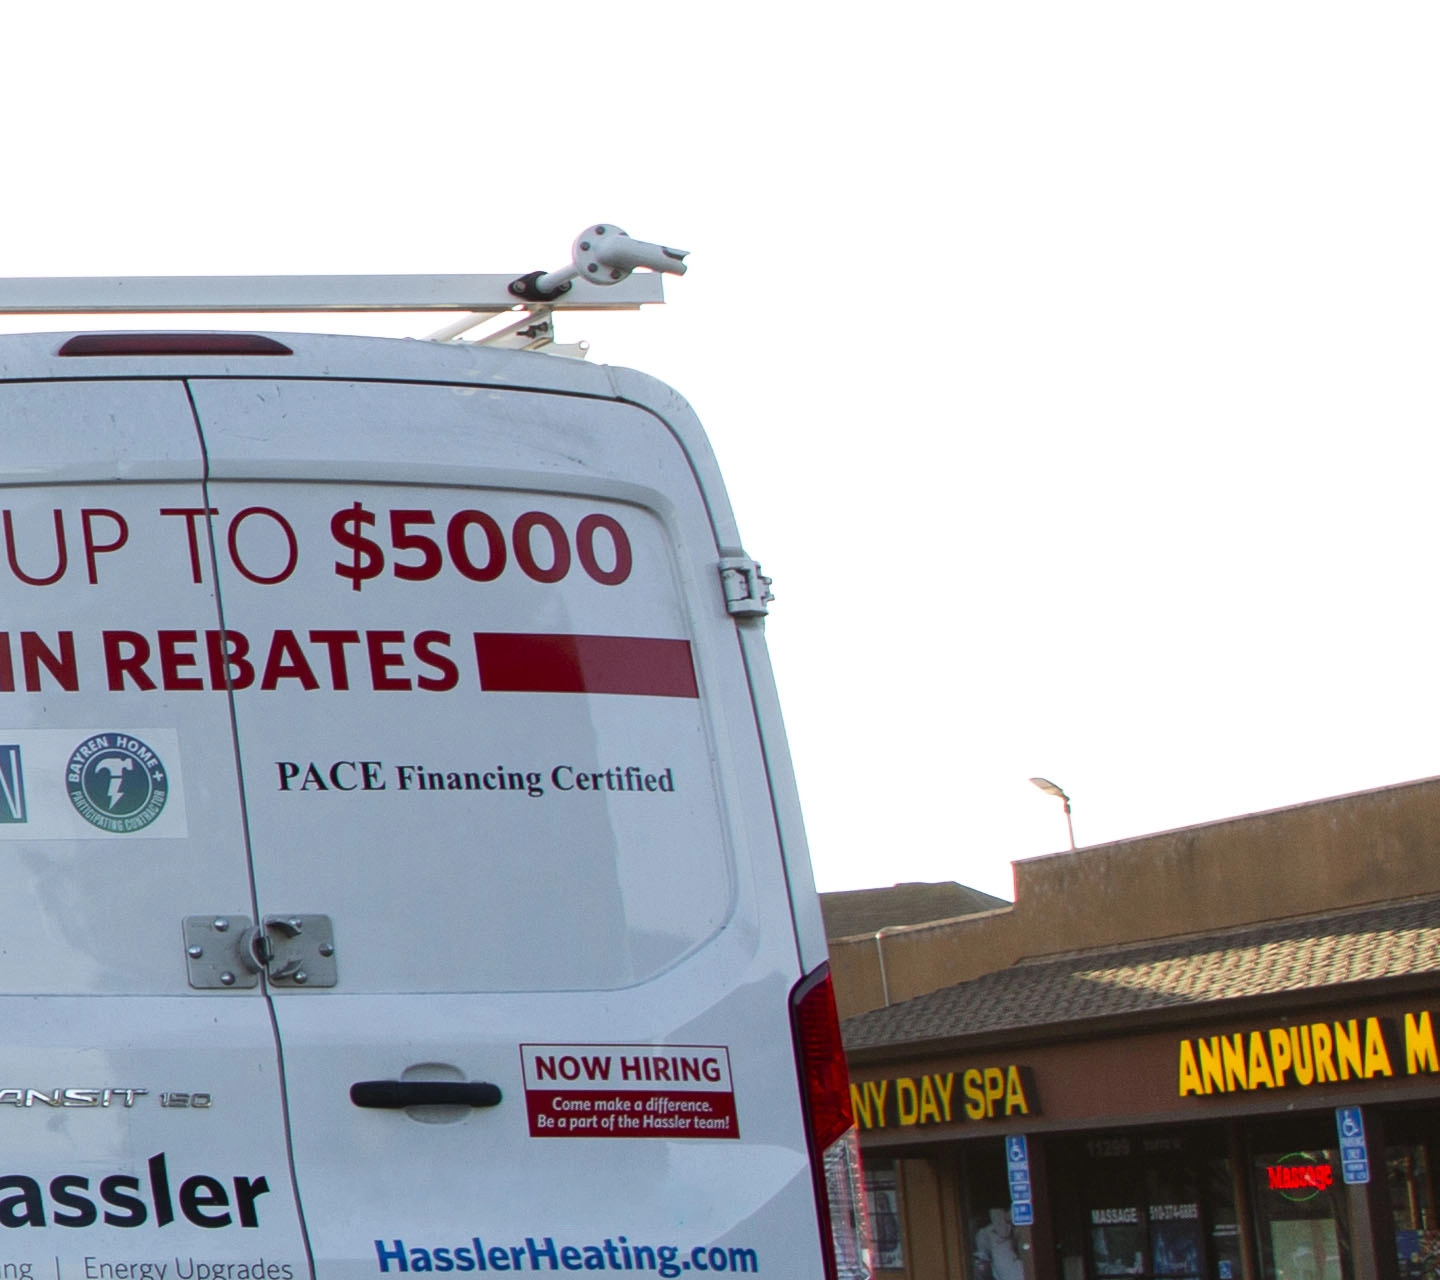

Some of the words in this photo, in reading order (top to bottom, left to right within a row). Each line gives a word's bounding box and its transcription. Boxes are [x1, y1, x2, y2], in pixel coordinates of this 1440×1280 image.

[2, 508, 130, 587] UP
[160, 506, 298, 585] TO
[330, 501, 634, 592] $5000
[102, 629, 460, 693] REBATES
[67, 735, 109, 783] BAYREN
[276, 760, 386, 792] PACE
[396, 765, 545, 797] Financing
[550, 765, 676, 794] Certified
[534, 1055, 614, 1081] NOW
[619, 1056, 722, 1083] HIRING
[1178, 1016, 1394, 1098] ANNAPURNA
[552, 1095, 592, 1113] Come
[594, 1096, 632, 1113] make
[634, 1100, 644, 1113] a
[645, 1096, 714, 1116] difference.
[896, 1072, 955, 1126] DAY
[963, 1065, 1030, 1121] SPA
[536, 1114, 555, 1130] Be
[557, 1117, 566, 1130] a
[568, 1114, 600, 1133] part
[601, 1113, 617, 1133] of
[618, 1114, 640, 1130] the
[642, 1114, 691, 1130] Hassler
[693, 1115, 731, 1131] team!
[1091, 1206, 1140, 1226] MASSAGE
[374, 1236, 760, 1280] HasslerHeating.com
